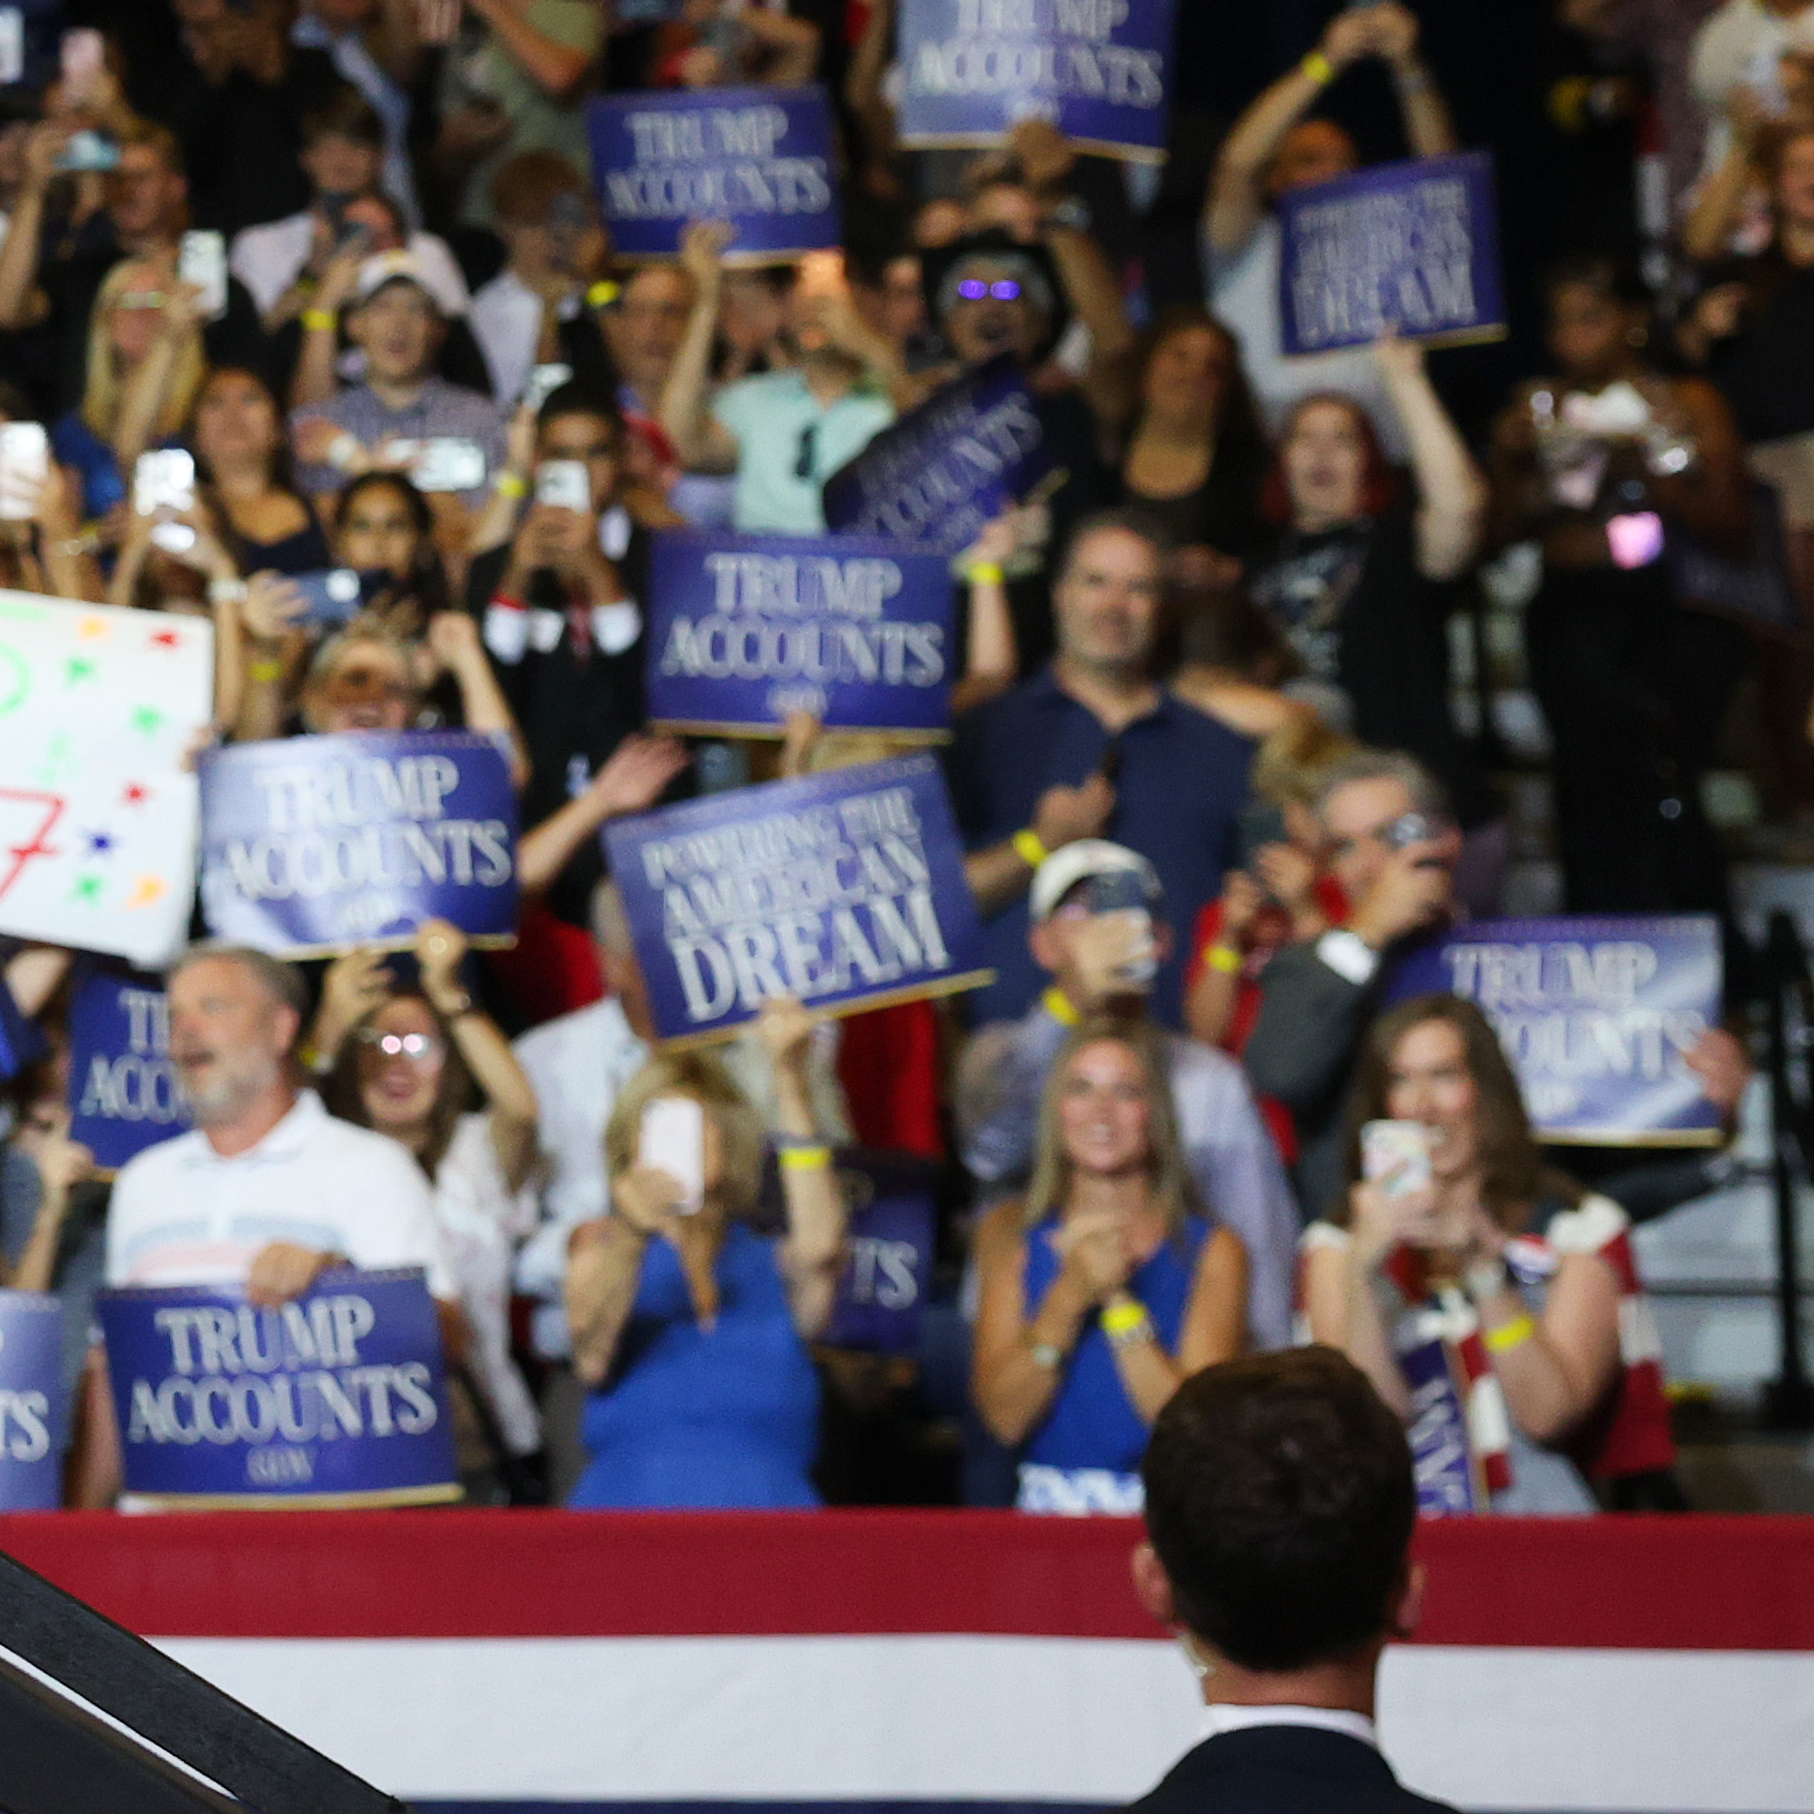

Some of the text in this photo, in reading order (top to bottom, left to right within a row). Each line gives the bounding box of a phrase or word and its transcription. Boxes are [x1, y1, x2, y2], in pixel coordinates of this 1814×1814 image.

[911, 34, 1164, 110] ACCOUNTS
[624, 103, 789, 166] TRUMP
[604, 154, 831, 221] ACCOUNTS
[704, 551, 904, 620] TRUMP
[659, 613, 946, 687] ACCOUNTS
[253, 754, 460, 831] TRUMP
[224, 818, 512, 903] ACCOUNTS
[662, 831, 932, 946] AMERICAN
[673, 886, 952, 1024] DREAM
[1440, 941, 1658, 1012] TRUMP
[154, 1293, 376, 1375] TRUMP
[128, 1361, 439, 1445] ACCOUNTS
